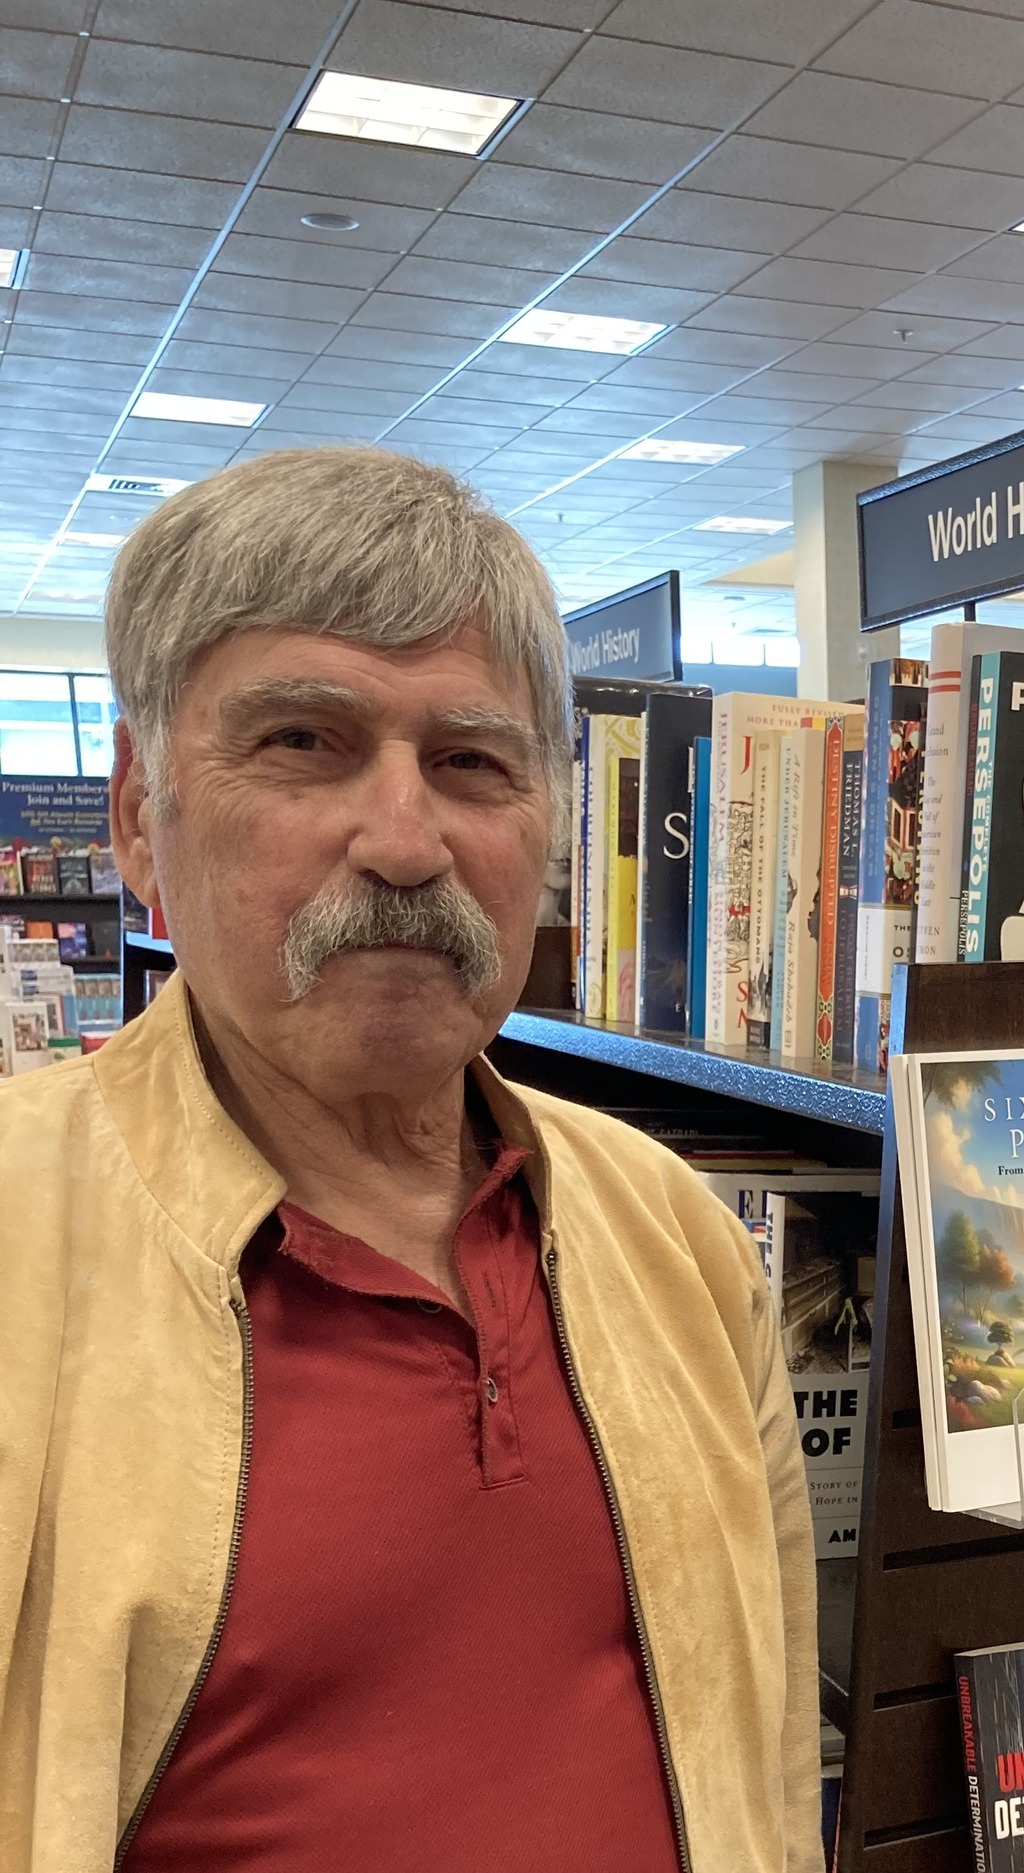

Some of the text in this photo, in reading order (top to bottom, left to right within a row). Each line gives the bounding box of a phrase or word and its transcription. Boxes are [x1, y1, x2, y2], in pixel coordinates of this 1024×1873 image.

[927, 492, 998, 562] World
[601, 627, 640, 665] History
[747, 716, 800, 728] MORE THA
[772, 704, 844, 718] FULLY REVISED
[2, 782, 55, 793] Premium
[851, 763, 861, 836] THOMAS
[843, 764, 852, 856] FRIEDMAN
[966, 677, 993, 953] PERSEPOLIS
[759, 836, 764, 852] OF
[827, 739, 841, 925] DESTINY DISRUPTED
[982, 795, 991, 873] COMPLETE
[958, 890, 969, 956] PERSEPOLIS
[998, 1166, 1024, 1176] From
[793, 1389, 858, 1419] THE
[802, 1427, 851, 1457] OF
[810, 1481, 859, 1491] STORY OF
[815, 1496, 858, 1506] HOPE IN
[958, 1675, 986, 1873] UNBREAKABLE DETERMINATIO
